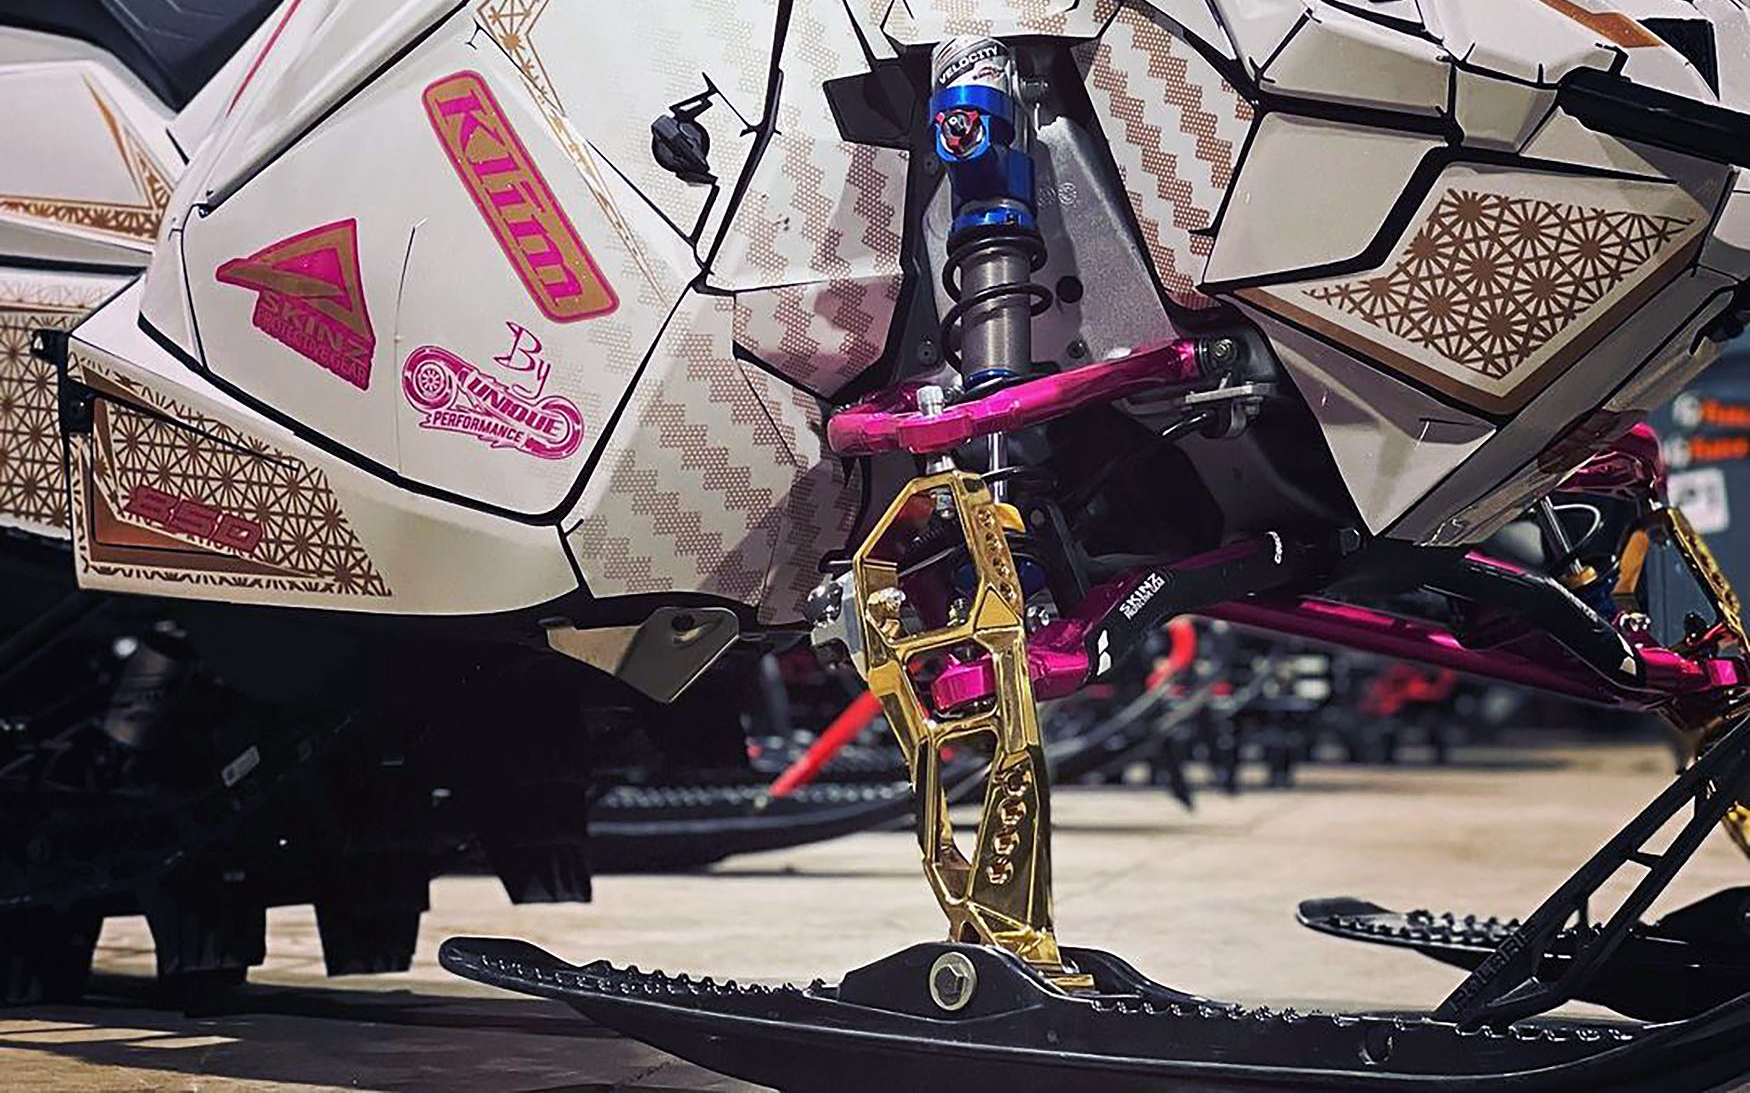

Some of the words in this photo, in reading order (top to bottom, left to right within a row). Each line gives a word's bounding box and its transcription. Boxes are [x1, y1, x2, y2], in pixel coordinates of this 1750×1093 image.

[938, 45, 999, 85] VELOCITY
[493, 321, 551, 400] By
[432, 410, 525, 444] PERFORMANCE
[1119, 572, 1158, 612] SKINZ
